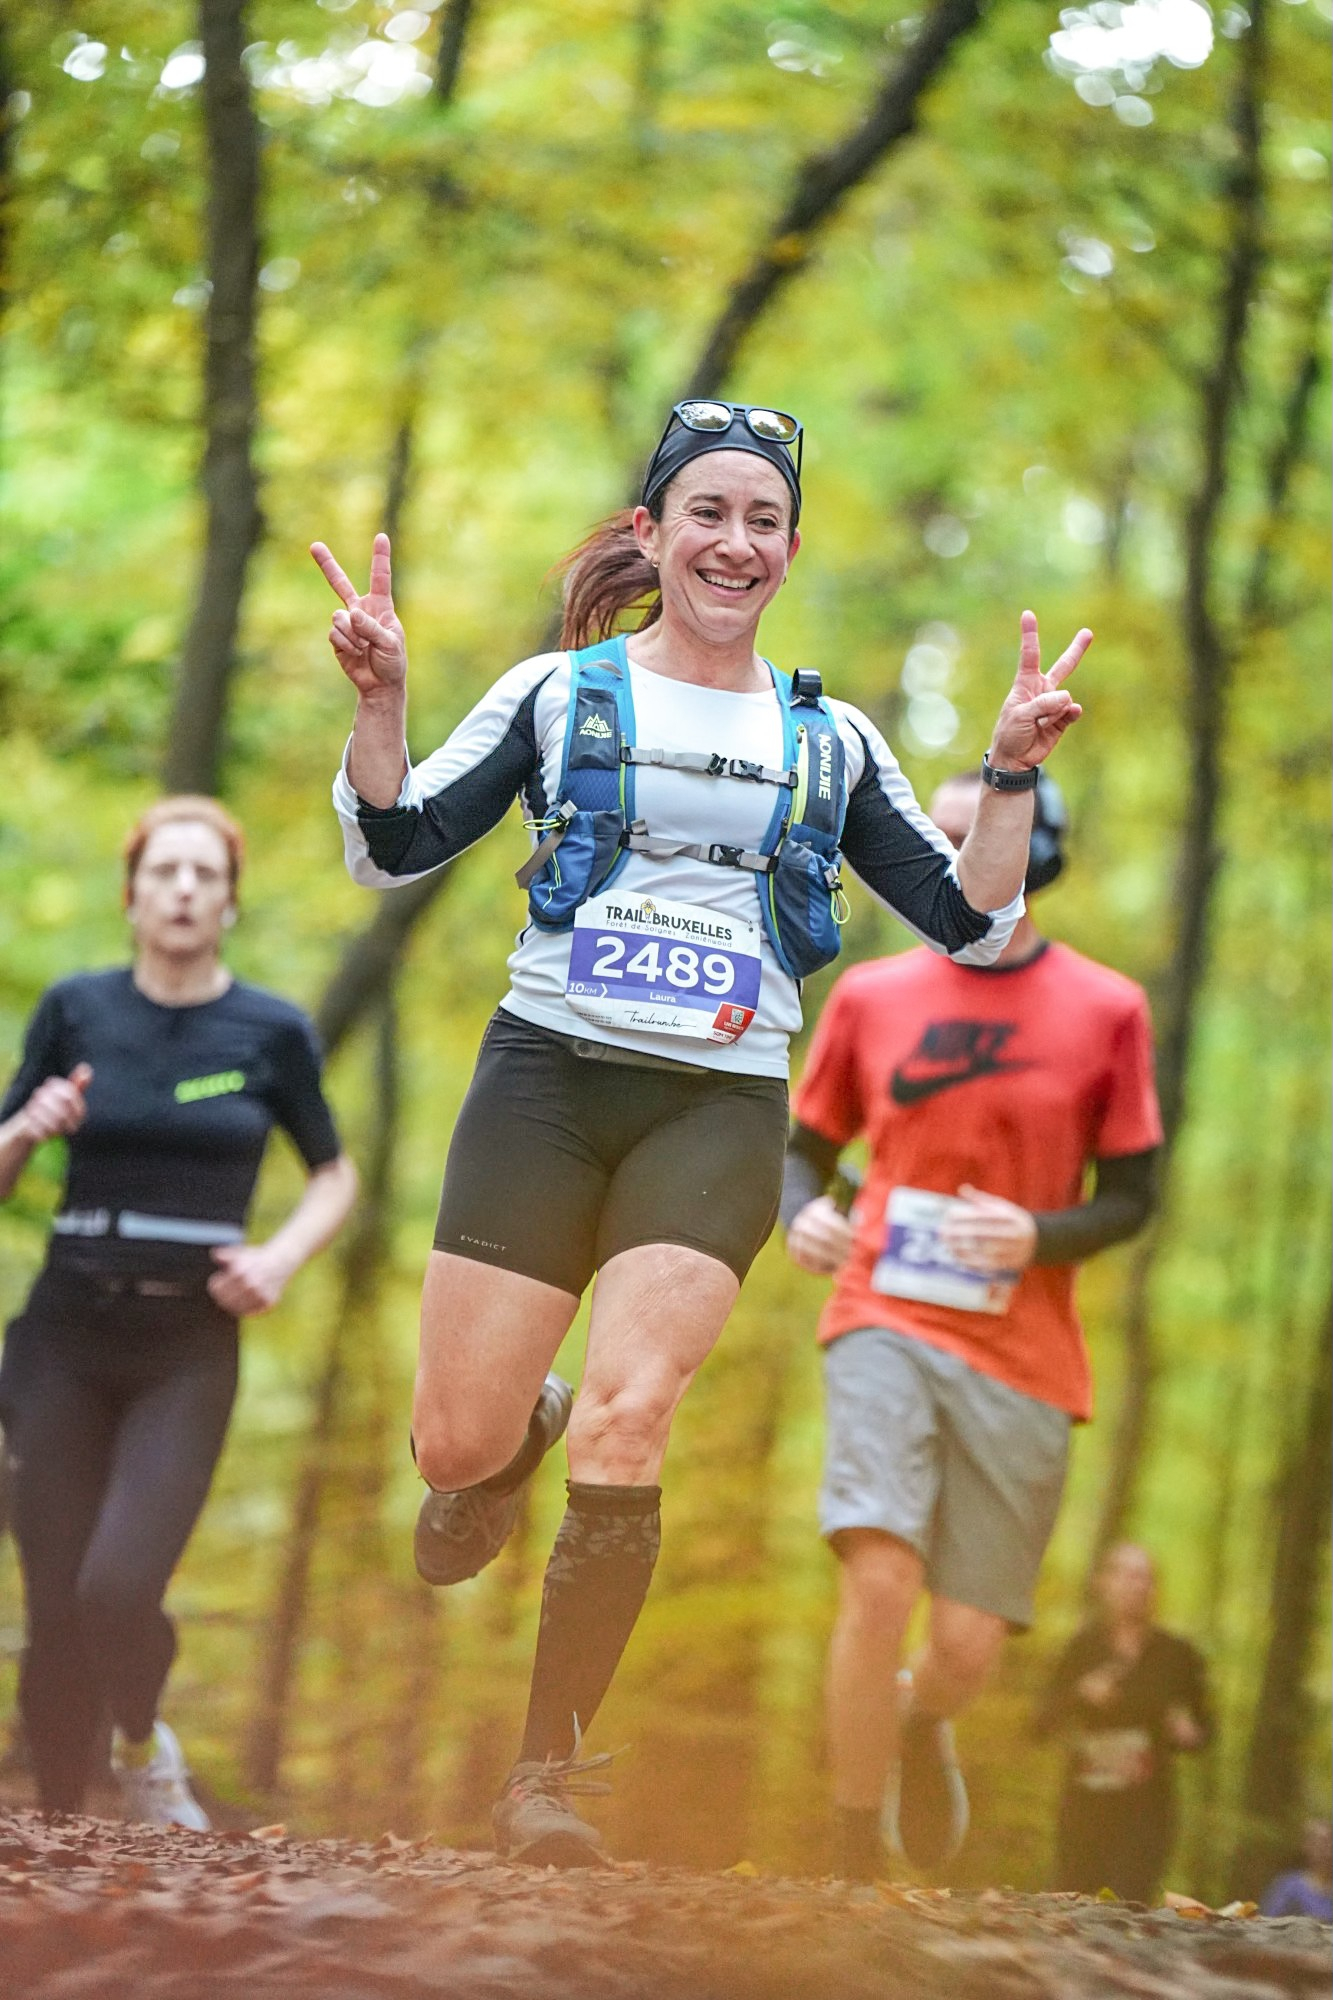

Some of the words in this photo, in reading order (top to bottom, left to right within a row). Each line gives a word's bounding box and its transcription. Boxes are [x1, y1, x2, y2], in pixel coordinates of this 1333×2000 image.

[818, 733, 832, 800] AONIJIE
[606, 905, 647, 923] TRAIL
[652, 912, 733, 941] BRUXELLES
[644, 924, 676, 936] Soignes
[592, 935, 735, 995] 2489
[649, 991, 676, 1003] Laura
[624, 1010, 697, 1028] Trailrun.be
[460, 1234, 507, 1252] EVADICT
